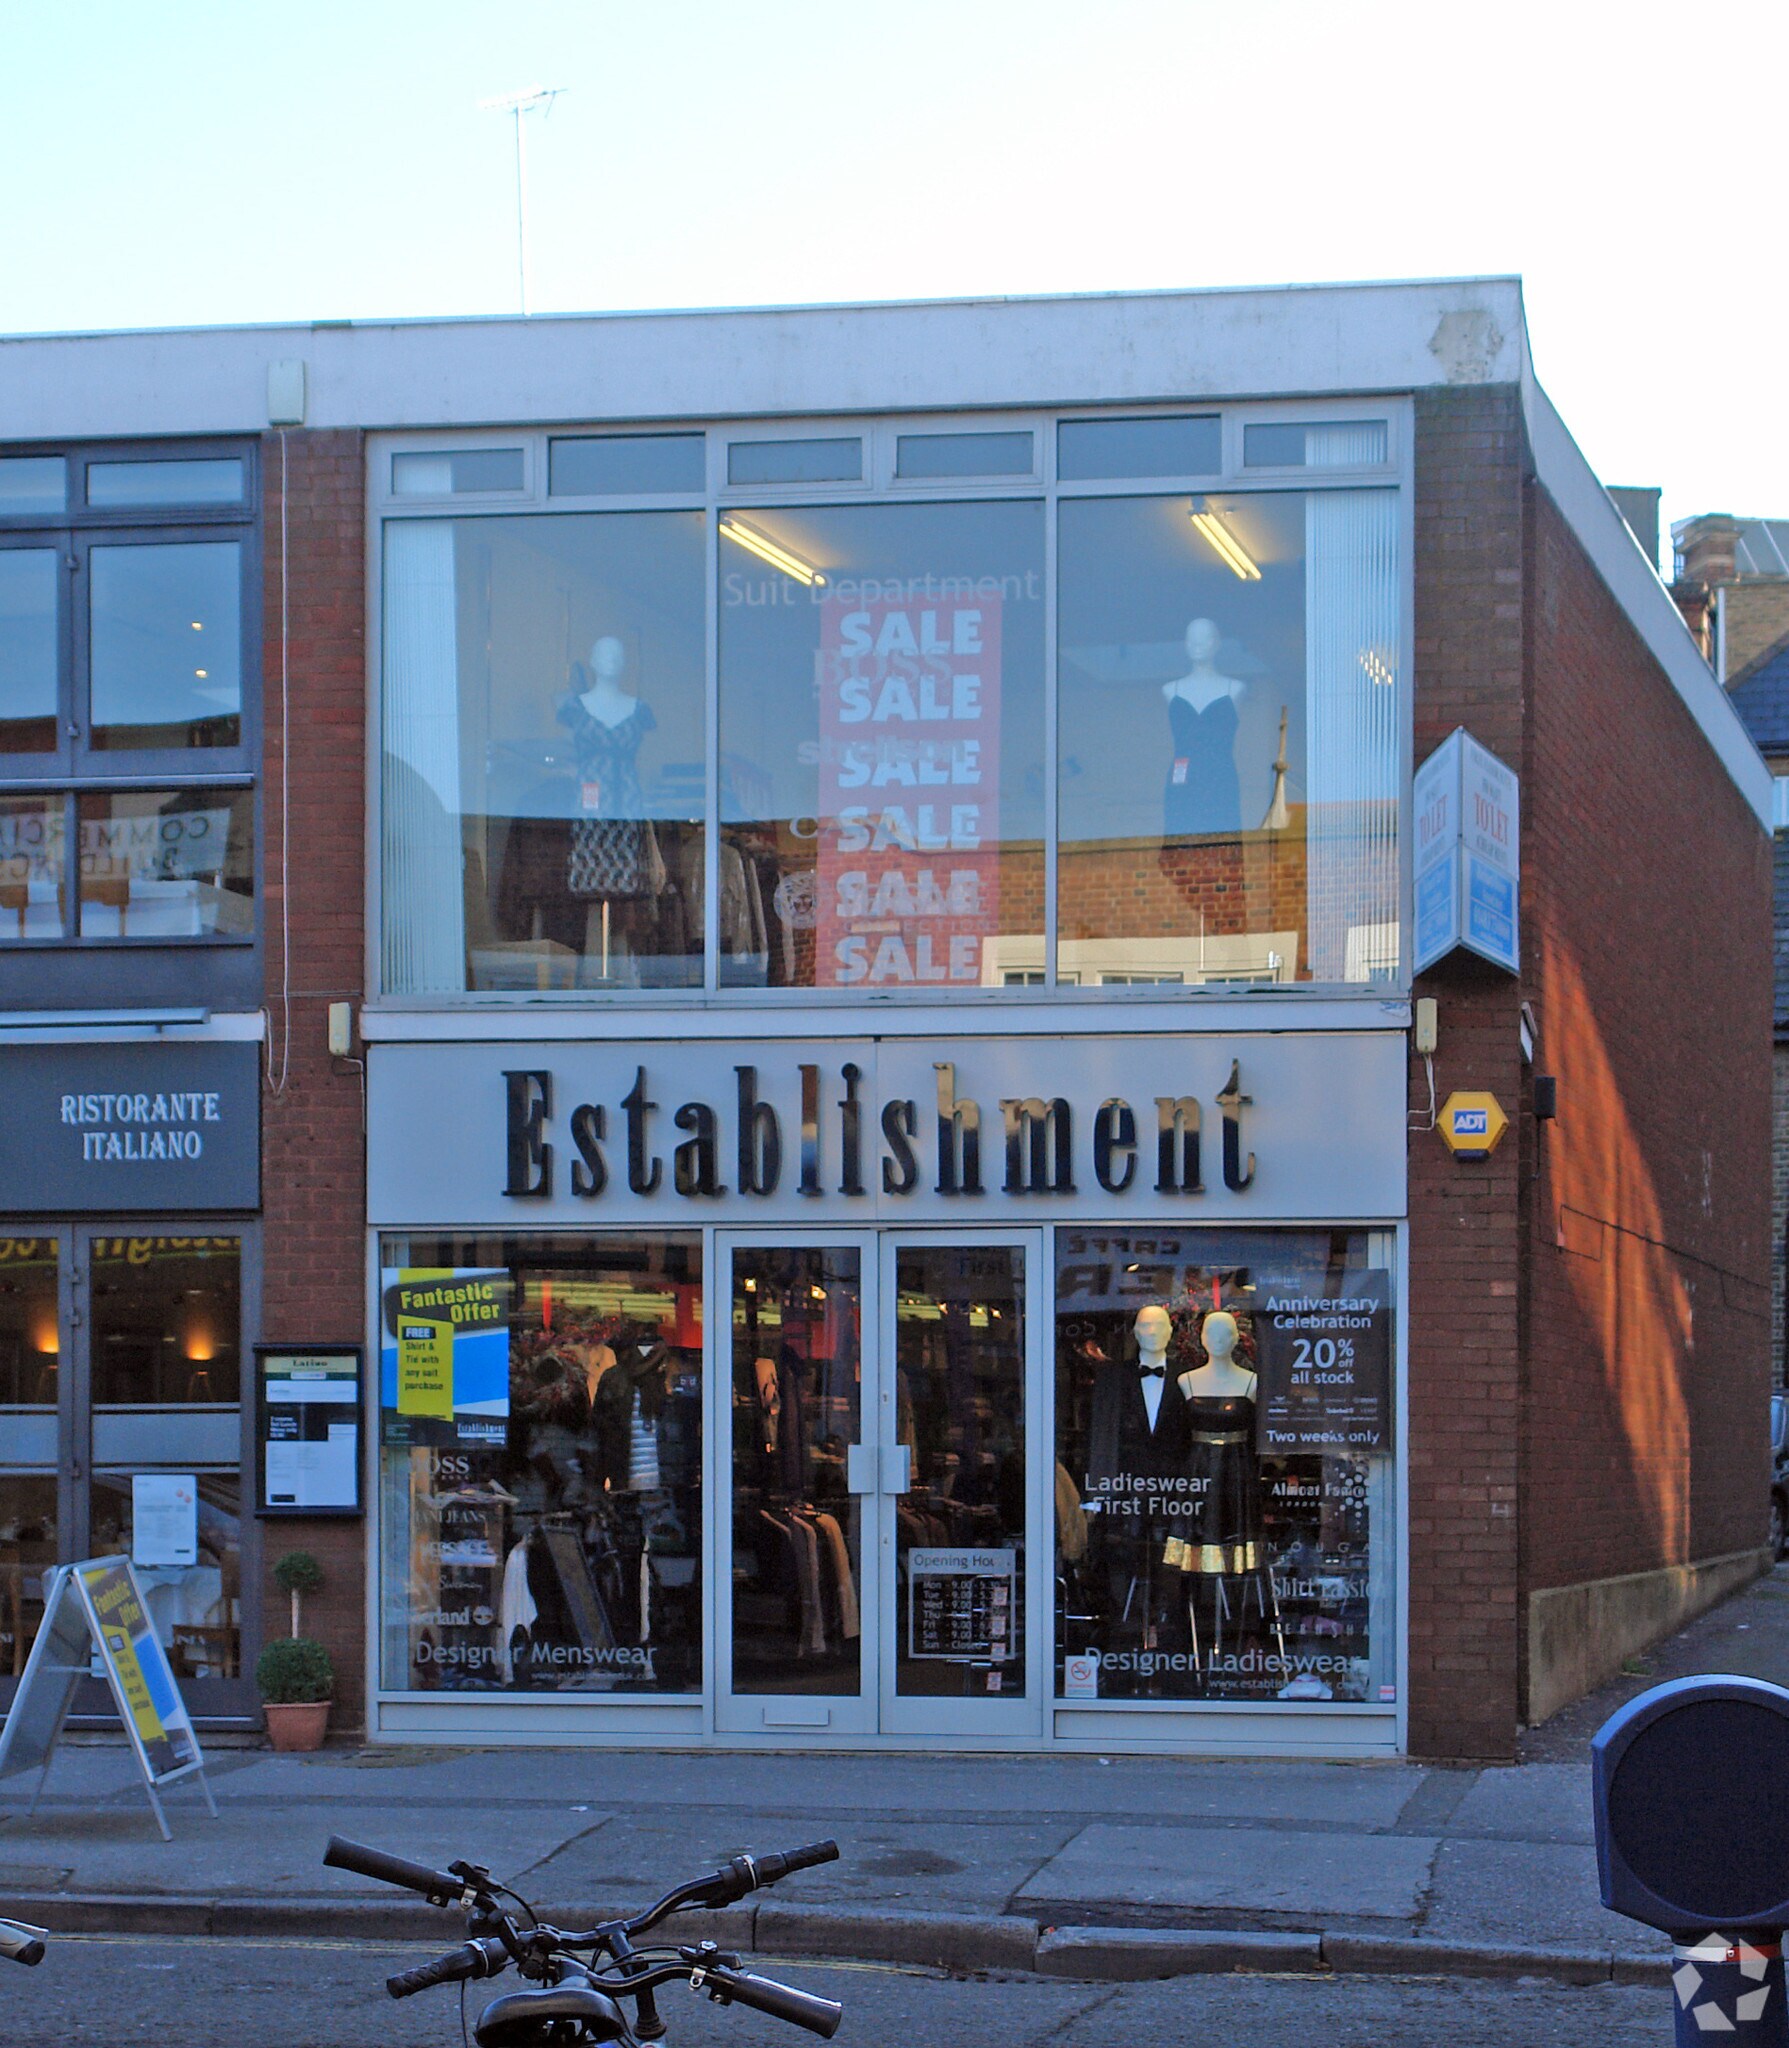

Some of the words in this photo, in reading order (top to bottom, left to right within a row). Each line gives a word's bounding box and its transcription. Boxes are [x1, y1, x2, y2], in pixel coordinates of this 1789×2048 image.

[724, 573, 797, 606] Suit
[811, 570, 1040, 612] Department
[840, 609, 982, 658] SALE
[838, 674, 982, 723] SALE
[838, 739, 981, 788] SALE
[837, 804, 981, 852] SALE
[1490, 804, 1509, 846] LET
[836, 870, 981, 917] SALE
[835, 935, 979, 982] SALE
[60, 1093, 221, 1125] RISTORANTE
[502, 1058, 1255, 1199] Establishment
[1455, 1114, 1486, 1129] ADT
[83, 1131, 201, 1160] ITALIANO
[401, 1283, 493, 1309] Fantastic
[1265, 1296, 1379, 1314] Anniversary
[451, 1303, 500, 1323] Offer
[1274, 1315, 1371, 1328] Celebration
[406, 1328, 430, 1338] FREE
[406, 1342, 426, 1350] Shirt
[1293, 1338, 1354, 1369] 20%
[1338, 1359, 1354, 1368] off
[406, 1355, 418, 1363] Tie
[422, 1355, 439, 1363] with
[423, 1369, 438, 1377] suit
[1291, 1372, 1309, 1384] all
[1314, 1371, 1354, 1384] stock
[405, 1382, 443, 1391] purchase
[1266, 1430, 1296, 1442] Two
[1300, 1430, 1344, 1442] weeks
[1349, 1430, 1379, 1444] only
[1085, 1473, 1211, 1492] Ladieswear
[1272, 1483, 1320, 1496] Almost
[1093, 1497, 1141, 1515] First
[1149, 1497, 1204, 1516] Floor
[914, 1554, 968, 1568] Opening
[923, 1581, 942, 1589] Mon
[952, 1581, 972, 1589] 9.00
[1272, 1577, 1313, 1598] Shirt
[923, 1591, 940, 1599] Tue
[952, 1591, 972, 1599] 9.00
[923, 1601, 943, 1609] Wed
[952, 1601, 972, 1609] 9.00
[923, 1610, 941, 1618] Thu
[923, 1620, 936, 1628] Fri
[952, 1620, 972, 1629] 9.00
[923, 1630, 937, 1639] Sat
[952, 1630, 972, 1639] 9.00
[531, 1641, 658, 1666] Menswear
[923, 1640, 940, 1649] Sun
[952, 1640, 982, 1649] Closed
[1085, 1647, 1198, 1676] Designer
[1208, 1649, 1361, 1674] Ladieswear
